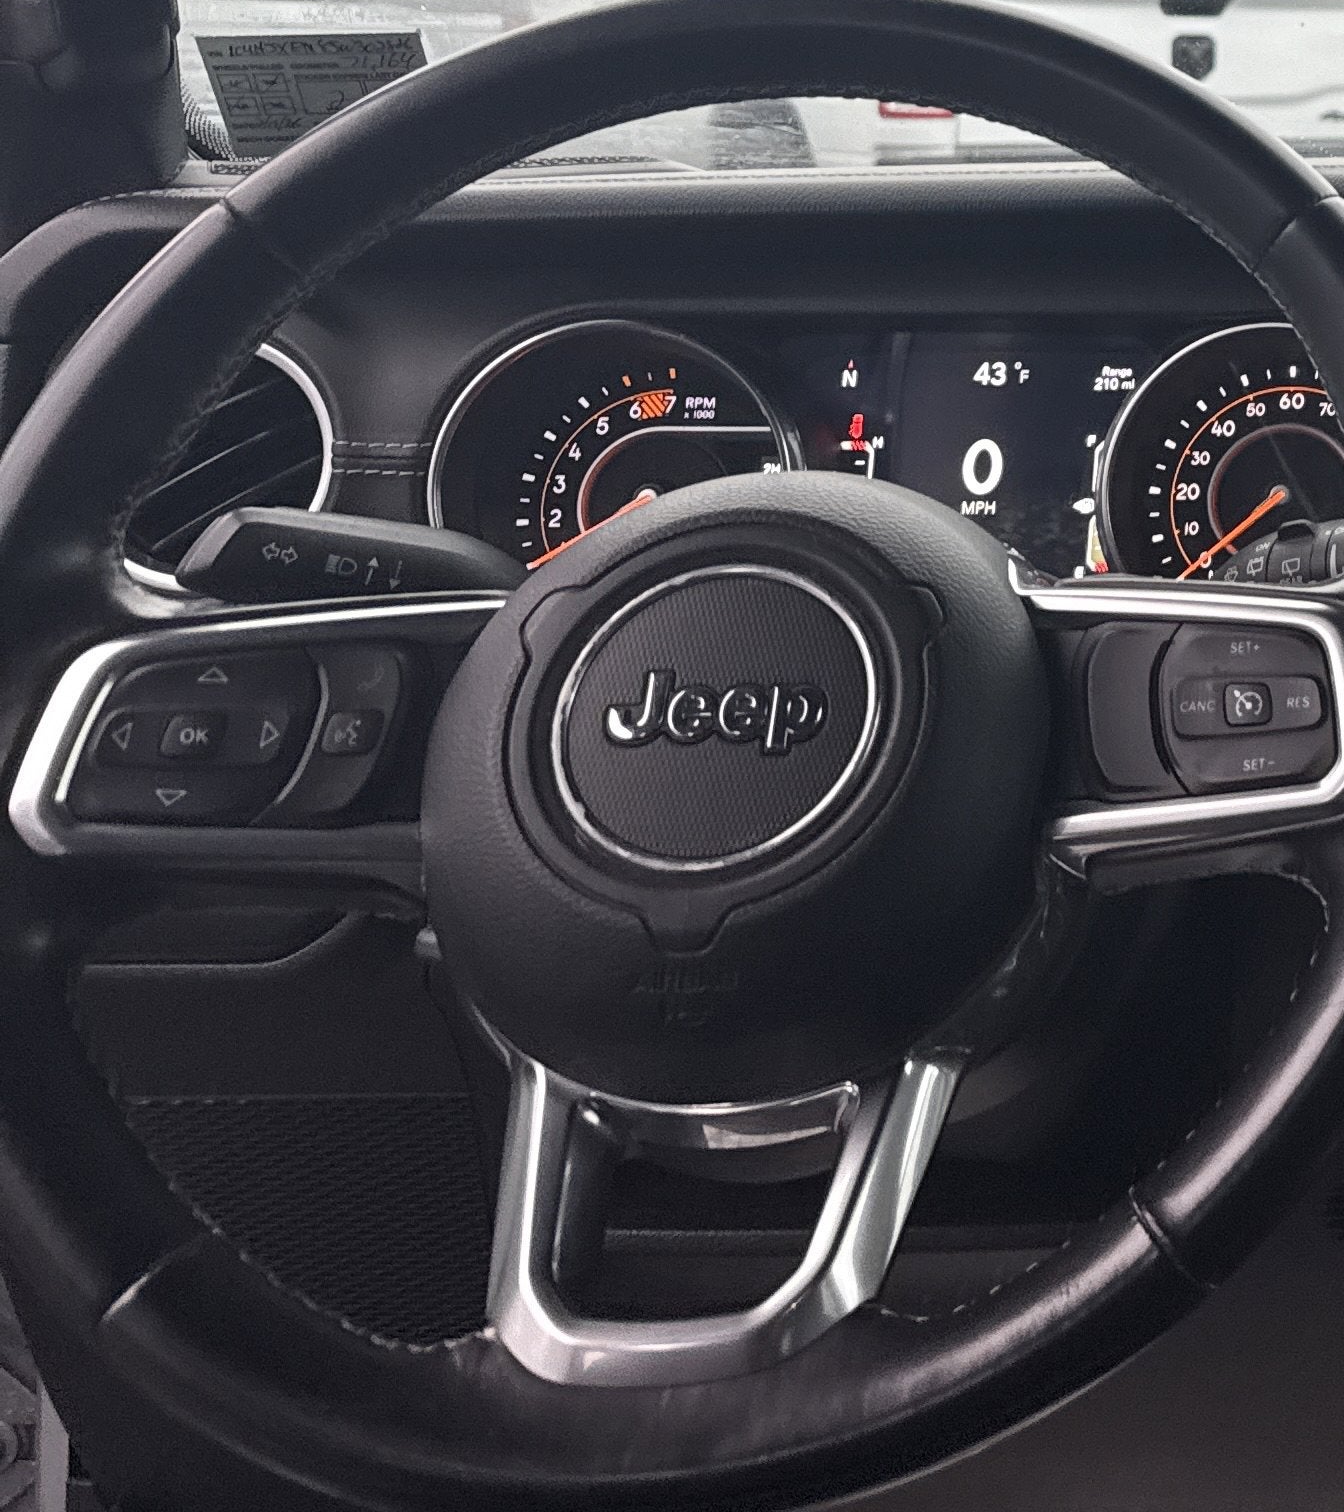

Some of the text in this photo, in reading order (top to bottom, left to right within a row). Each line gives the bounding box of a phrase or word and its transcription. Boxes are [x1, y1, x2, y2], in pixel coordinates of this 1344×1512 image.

[841, 370, 858, 388] N
[973, 363, 1007, 386] 43
[1101, 366, 1132, 378] Range
[1093, 378, 1136, 391] 210 mi
[664, 396, 677, 414] 7
[685, 396, 716, 409] RPM
[1246, 402, 1266, 417] 50
[1279, 393, 1305, 409] 60
[1319, 401, 1336, 416] 70
[629, 402, 642, 419] 6
[693, 409, 715, 420] 1000
[596, 417, 609, 435] 5
[1211, 419, 1235, 437] 40
[568, 443, 581, 461] 4
[1191, 451, 1211, 466] 30
[962, 438, 1003, 495] 0
[553, 475, 566, 494] 3
[1176, 483, 1201, 500] 20
[961, 500, 996, 516] MPH
[548, 509, 561, 528] 2
[1184, 521, 1199, 536] 10
[1180, 699, 1216, 713] CANC
[1286, 696, 1311, 710] RES
[604, 669, 831, 756] Jeep
[180, 725, 208, 746] OK
